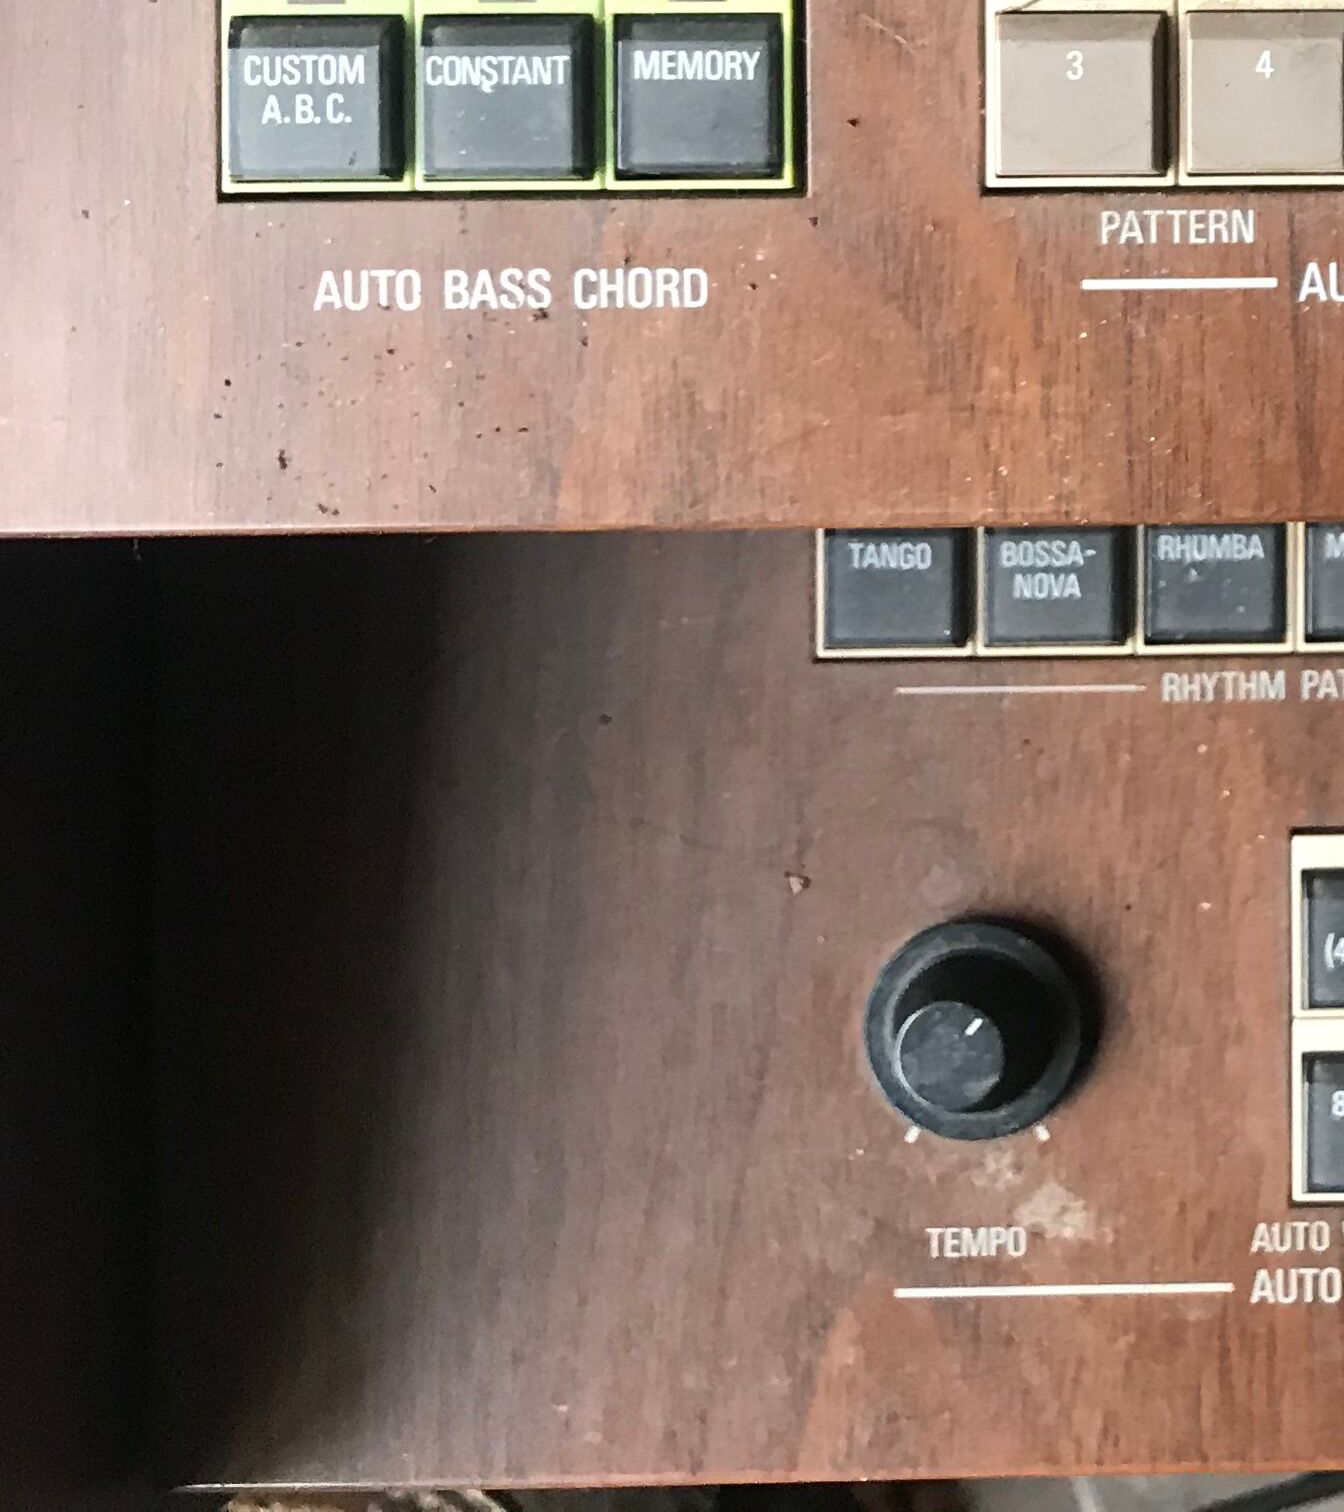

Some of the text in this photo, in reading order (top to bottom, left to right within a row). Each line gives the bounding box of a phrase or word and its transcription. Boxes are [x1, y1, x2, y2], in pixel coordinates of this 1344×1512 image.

[243, 54, 365, 87] CUSTOM
[425, 55, 570, 87] CONSTANT
[633, 49, 760, 81] MEMORY
[1066, 50, 1084, 81] 3
[1255, 50, 1275, 79] 4
[1100, 209, 1255, 245] PATTERN
[313, 266, 708, 312] AUTO BASS CHORD
[848, 542, 932, 571] TANGO
[998, 539, 1097, 569] BOSSA-
[1157, 533, 1265, 564] RHUMBA
[1012, 572, 1082, 600] NOVA
[1161, 669, 1286, 703] RHYTHM
[925, 1226, 1026, 1259] TEMPO
[1250, 1220, 1331, 1254] AUTO
[1249, 1266, 1344, 1305] AUTO
